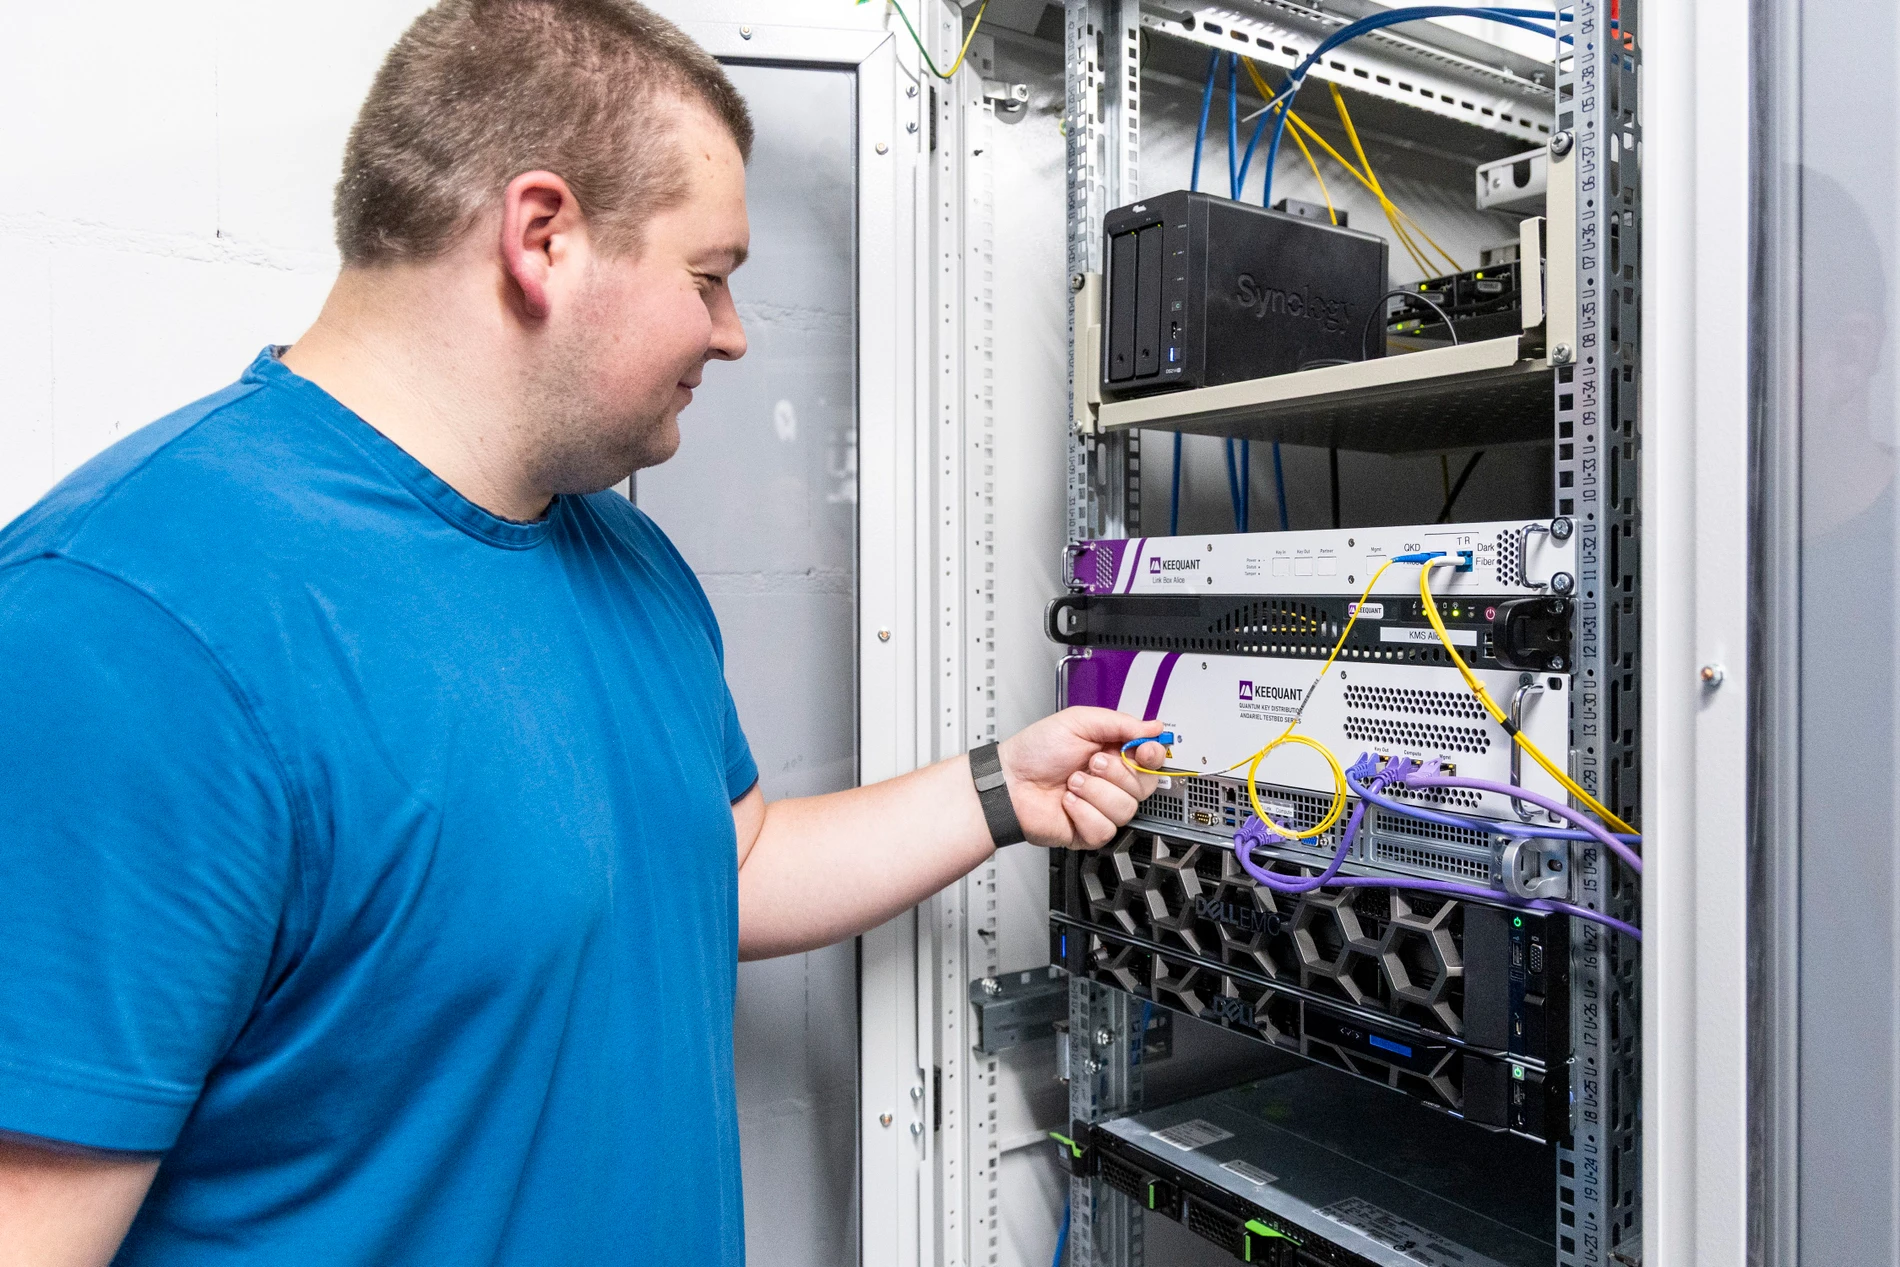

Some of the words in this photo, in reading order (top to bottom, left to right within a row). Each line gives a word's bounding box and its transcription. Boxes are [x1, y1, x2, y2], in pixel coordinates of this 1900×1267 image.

[1582, 19, 1594, 34] 04
[1582, 97, 1595, 113] 05
[1582, 176, 1595, 192] 06
[1582, 256, 1595, 270] 07
[1237, 273, 1354, 334] Synology
[1582, 333, 1595, 348] 08
[1582, 411, 1596, 426] 09
[1582, 490, 1596, 502] 10
[1457, 537, 1462, 545] T
[1464, 536, 1470, 544] R
[1477, 543, 1494, 552] Dark
[1162, 559, 1200, 571] KEEQUANT
[1476, 557, 1495, 566] Fiber
[1582, 570, 1596, 580] 11
[1409, 631, 1426, 640] KMS
[1582, 646, 1596, 658] 12
[1255, 686, 1302, 701] KEEQUANT
[1583, 724, 1596, 736] 13
[1583, 879, 1597, 892] 15
[1195, 894, 1240, 926] DELL
[1240, 907, 1280, 936] EMC
[1584, 957, 1597, 969] 16
[1214, 996, 1257, 1028] DELL
[1584, 1032, 1597, 1047] 17
[1584, 1110, 1597, 1124] 18
[1584, 1187, 1598, 1202] 19
